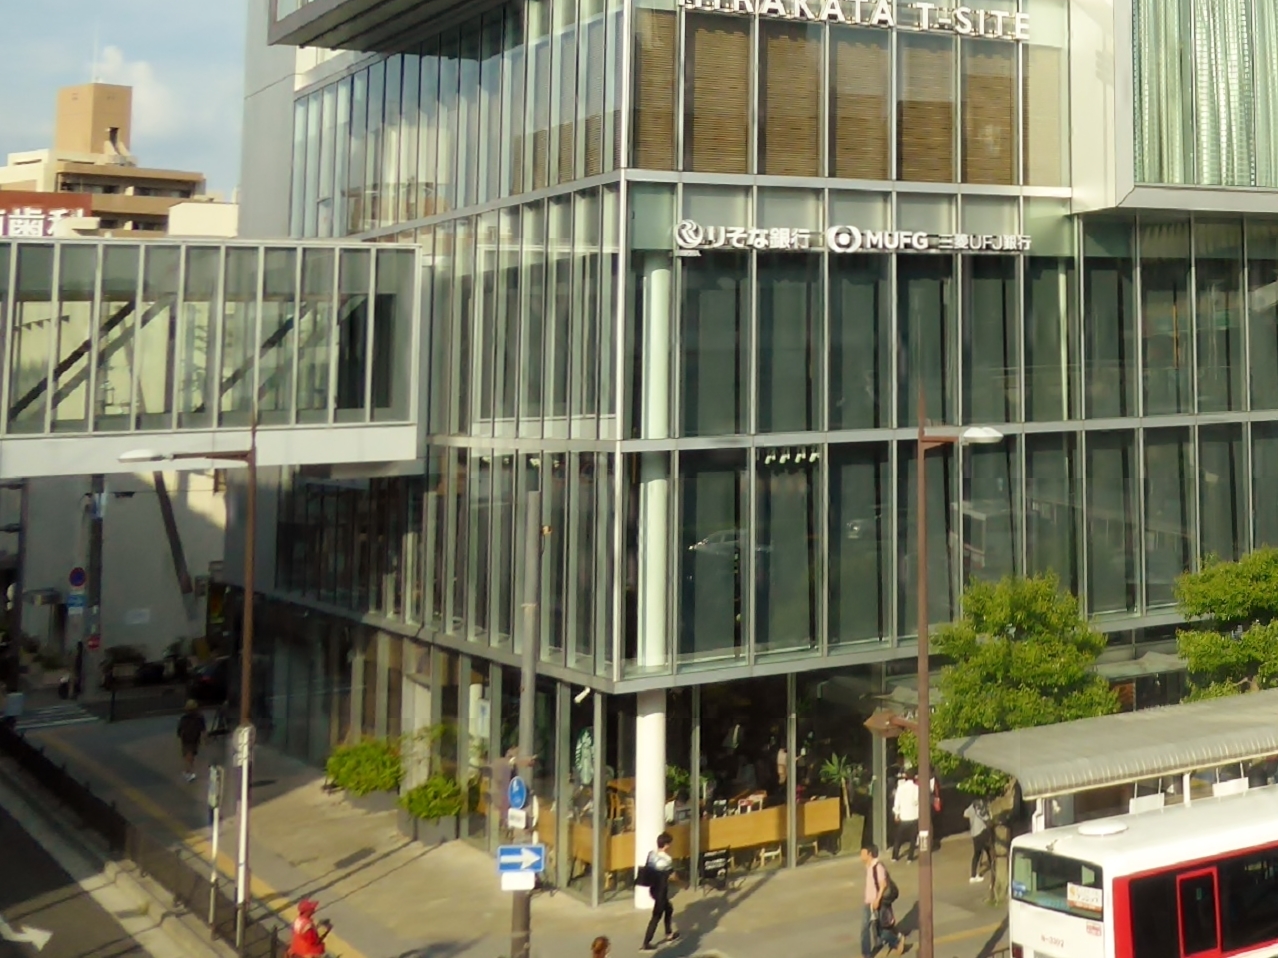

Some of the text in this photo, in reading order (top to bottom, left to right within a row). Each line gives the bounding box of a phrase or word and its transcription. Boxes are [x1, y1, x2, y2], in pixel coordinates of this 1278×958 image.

[915, 2, 1031, 40] T-SITE
[706, 225, 811, 249] りそな銀行
[865, 230, 929, 250] MUFG
[938, 233, 1032, 250] 三菱UFJ銀行
